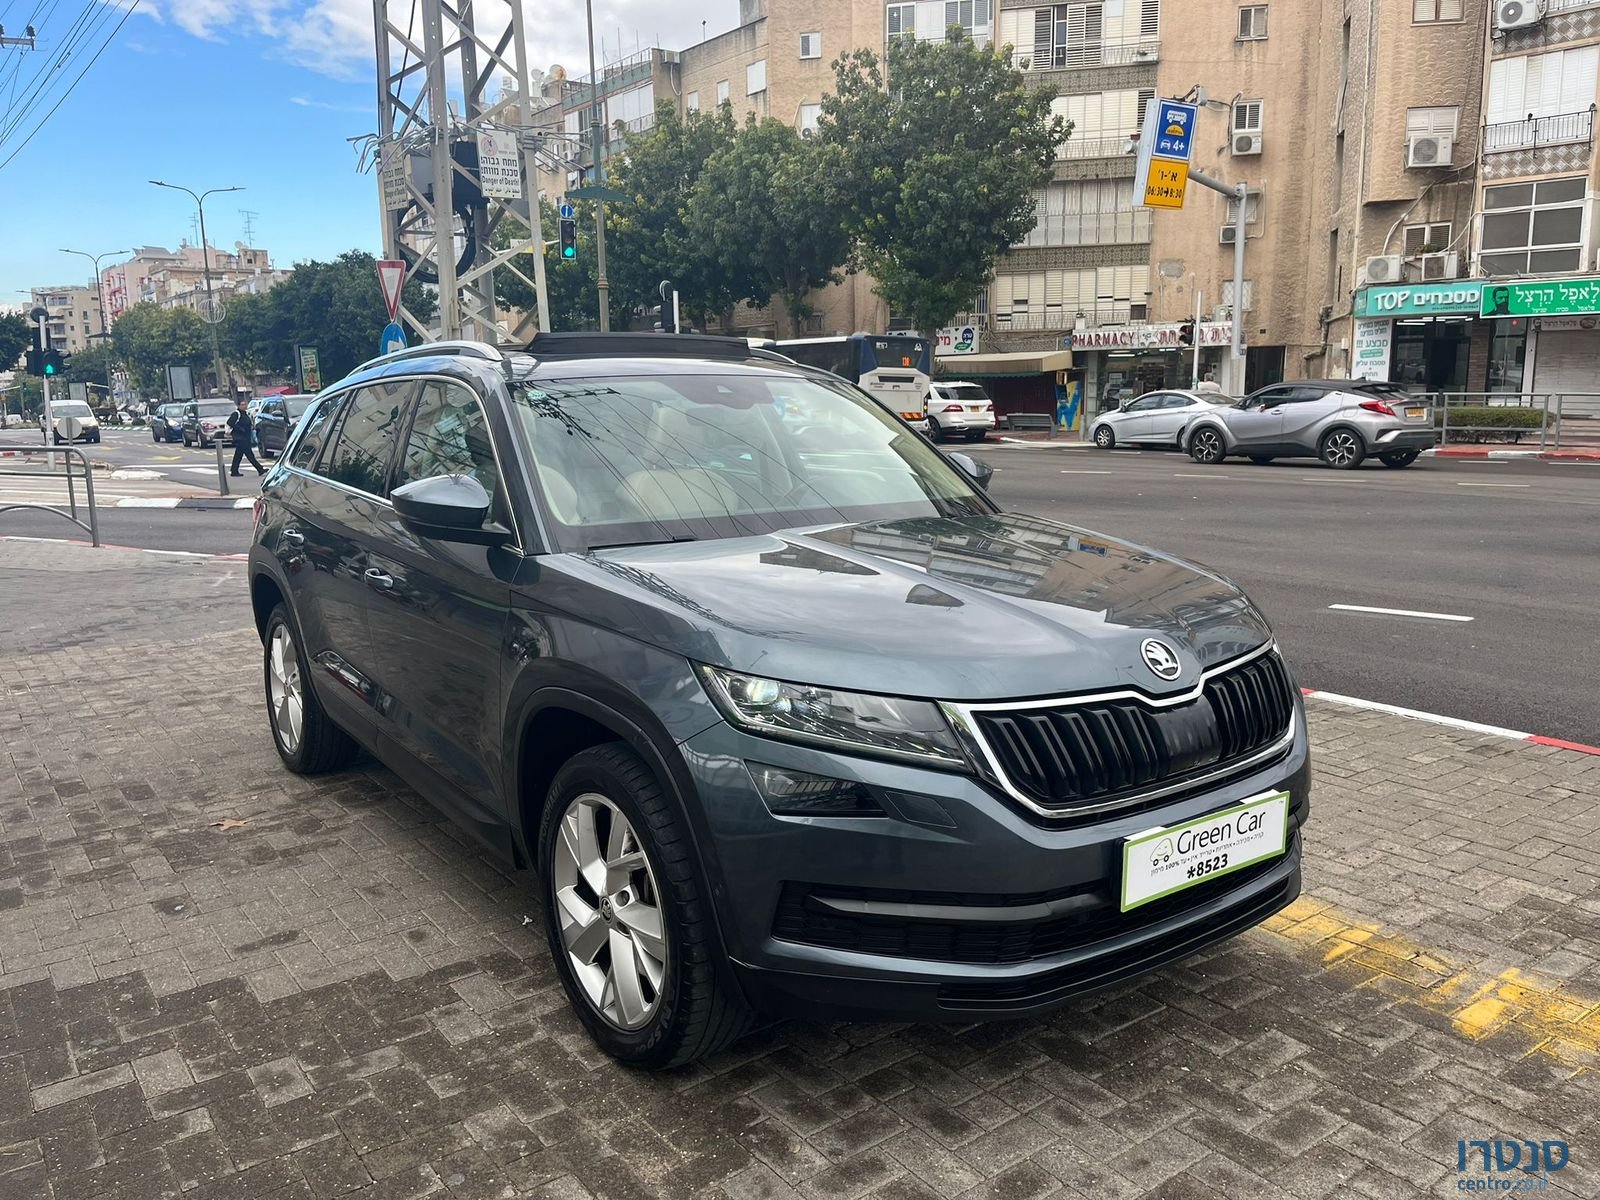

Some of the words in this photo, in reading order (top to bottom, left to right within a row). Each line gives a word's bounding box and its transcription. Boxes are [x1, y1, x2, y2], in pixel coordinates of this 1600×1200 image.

[1172, 139, 1185, 152] 4+
[502, 158, 518, 167] מתח
[501, 168, 518, 177] סכנת
[482, 175, 499, 186] Danger
[498, 177, 504, 185] of
[1374, 290, 1411, 311] TOP
[1072, 331, 1135, 347] PHARMACY
[1177, 823, 1231, 855] Green
[1237, 811, 1266, 835] Car
[1165, 860, 1180, 871] 100%
